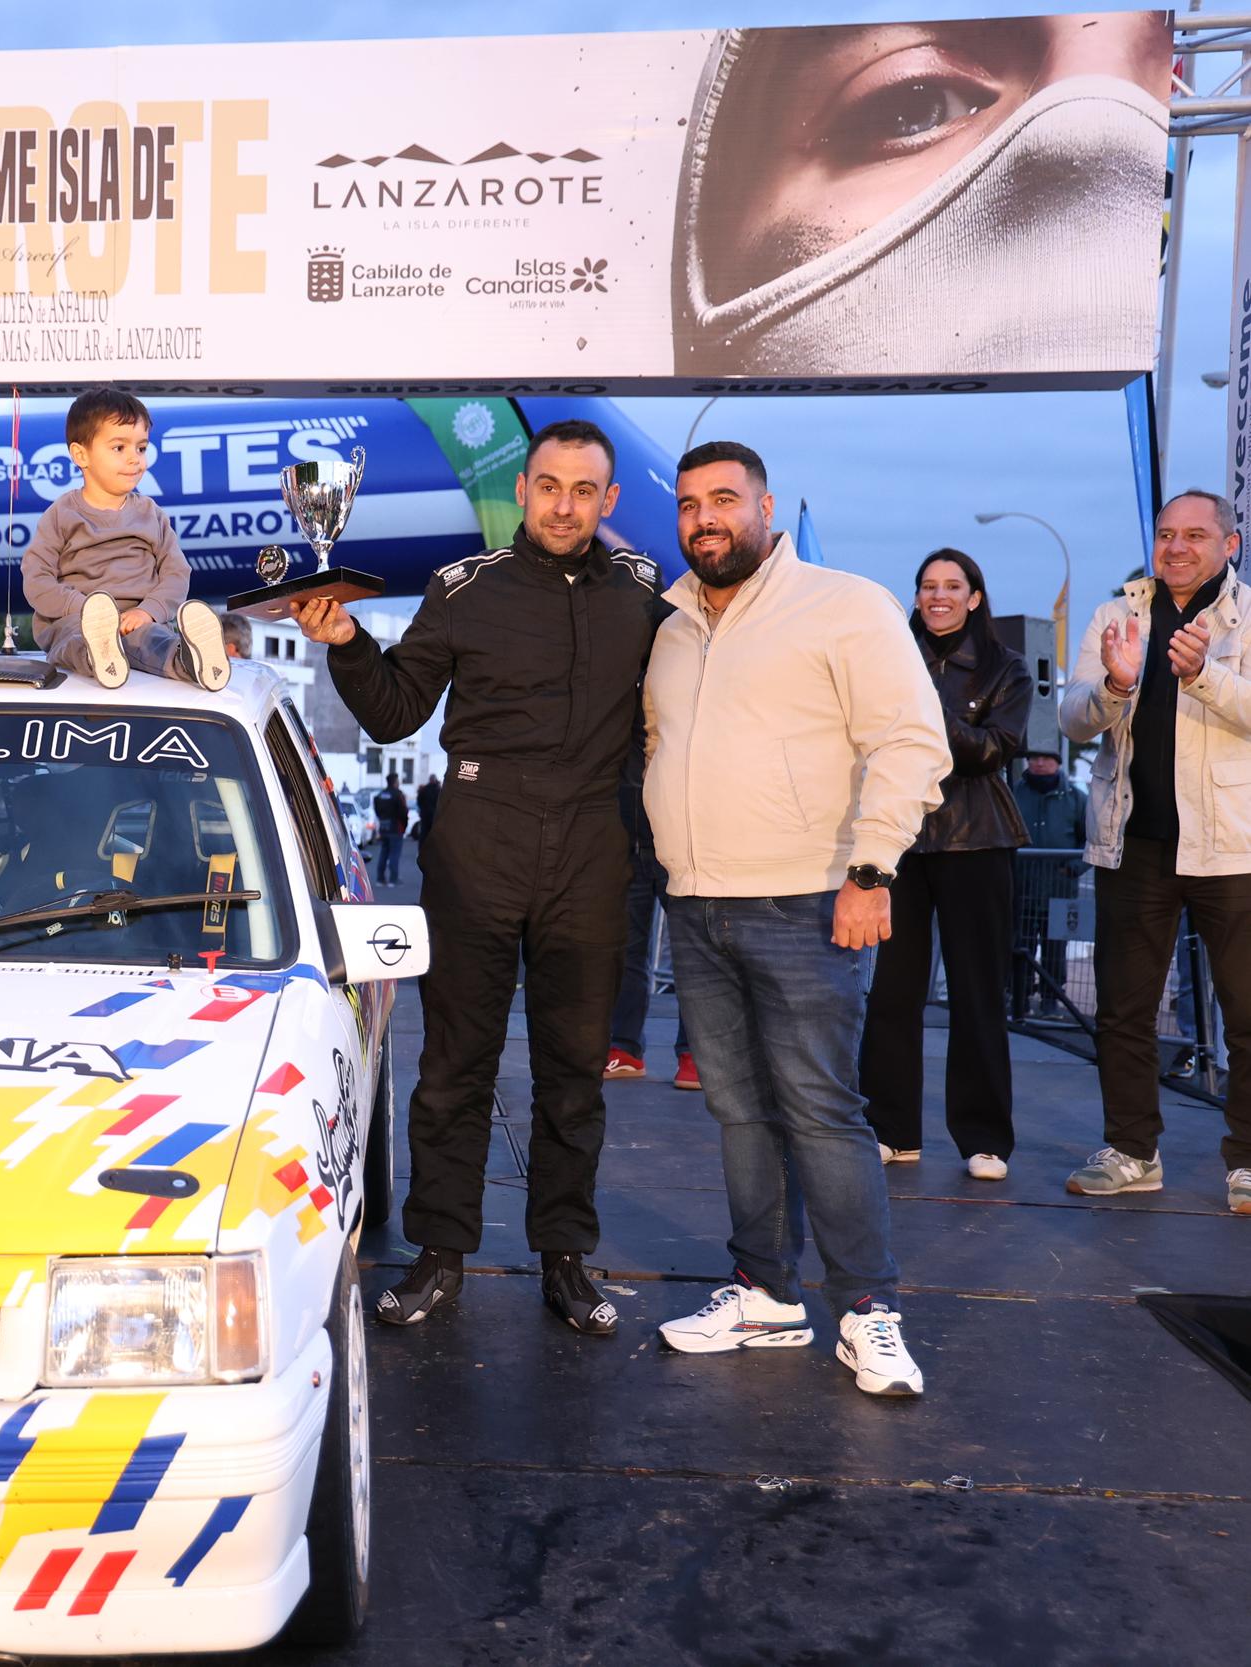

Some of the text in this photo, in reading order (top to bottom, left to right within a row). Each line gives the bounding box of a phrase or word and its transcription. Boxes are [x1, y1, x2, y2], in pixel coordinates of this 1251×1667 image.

[49, 126, 121, 224] ISLA
[132, 125, 176, 221] DE
[312, 175, 604, 210] LANZAROTE
[383, 217, 531, 231] LA ISLA DIFERENTE
[351, 262, 452, 281] Cabildo de
[515, 258, 566, 276] Islas
[351, 281, 445, 298] Lanzarote
[465, 276, 567, 295] Canarias
[36, 300, 47, 324] de
[49, 289, 109, 324] ASFALTO
[41, 328, 101, 362] INSULAR
[103, 336, 113, 361] de
[116, 327, 203, 361] LANZAROTE
[327, 383, 607, 396] Orvecame
[691, 379, 990, 393] Orvecame
[443, 564, 465, 580] OMP
